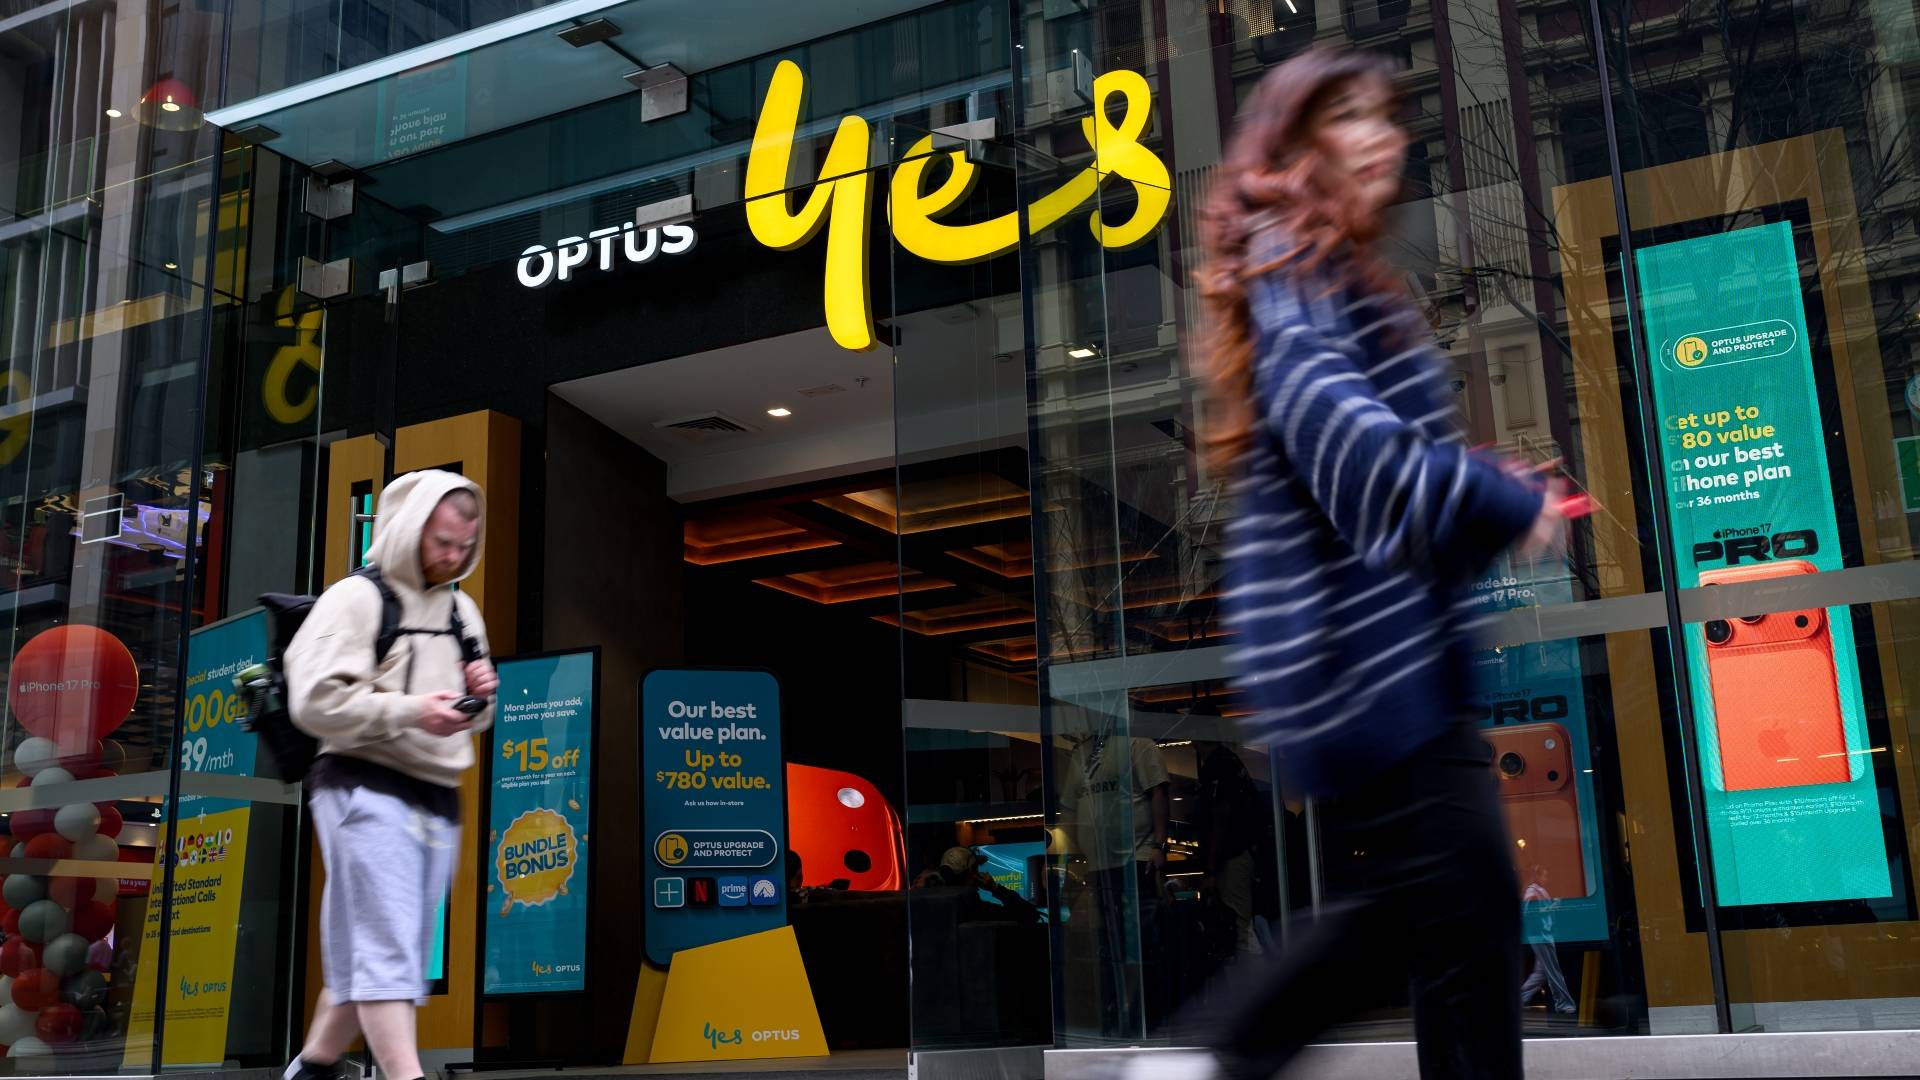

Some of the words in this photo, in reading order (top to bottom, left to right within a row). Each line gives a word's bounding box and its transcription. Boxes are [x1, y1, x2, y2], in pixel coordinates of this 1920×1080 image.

[744, 60, 1172, 351] yes
[516, 221, 696, 288] OPTUS
[1711, 336, 1742, 348] OPTUS
[1743, 329, 1787, 343] UPGRADE
[1712, 346, 1733, 356] AND
[1733, 338, 1776, 352] PROTECT
[1703, 410, 1731, 428] up
[1735, 405, 1760, 421] to
[1716, 423, 1776, 444] value
[1694, 452, 1730, 469] our
[1733, 442, 1785, 464] best
[1743, 464, 1792, 488] plan
[1696, 496, 1712, 507] 36
[1714, 490, 1761, 505] months
[1722, 526, 1760, 539] iPhone
[1760, 523, 1772, 534] 17
[1692, 529, 1819, 568] PRO
[1503, 576, 1518, 587] to
[1492, 589, 1505, 602] 17
[1507, 588, 1536, 600] Pro.
[207, 661, 236, 681] student
[236, 655, 254, 673] deal
[26, 681, 65, 693] iPhone
[66, 680, 79, 691] 17
[81, 679, 101, 690] Pro
[504, 703, 526, 712] More
[526, 701, 548, 712] plans
[548, 699, 563, 710] you
[565, 696, 583, 707] add,
[668, 700, 708, 719] Our
[711, 700, 757, 719] best
[503, 713, 517, 723] the
[518, 711, 540, 721] more
[540, 711, 555, 721] you
[556, 708, 578, 718] save.
[658, 722, 714, 740] value
[718, 722, 767, 745] plan.
[502, 737, 549, 772] $15
[552, 746, 581, 769] off
[685, 749, 715, 772] Up
[718, 751, 743, 768] to
[501, 780, 519, 790] eligible
[519, 779, 530, 789] plan
[530, 780, 540, 788] you
[515, 773, 533, 781] month
[656, 770, 707, 790] $780
[711, 771, 771, 789] value.
[684, 799, 697, 807] Ask
[705, 799, 719, 807] how
[719, 799, 745, 807] in-store
[504, 832, 567, 861] BUNDLE
[693, 841, 722, 850] OPTUS
[723, 841, 765, 850] UPGRADE
[693, 849, 713, 858] AND
[714, 849, 753, 858] PROTECT
[505, 849, 569, 880] BONUS
[188, 874, 222, 890] Standard
[721, 883, 747, 894] prime
[197, 890, 217, 903] Calls
[148, 910, 160, 922] and
[181, 925, 212, 935] destinations
[531, 960, 553, 977] yes
[555, 964, 581, 973] OPTUS
[180, 975, 199, 1000] yes
[203, 981, 227, 993] OPTUS
[703, 1021, 743, 1050] yes
[751, 1029, 800, 1042] OPTUS
